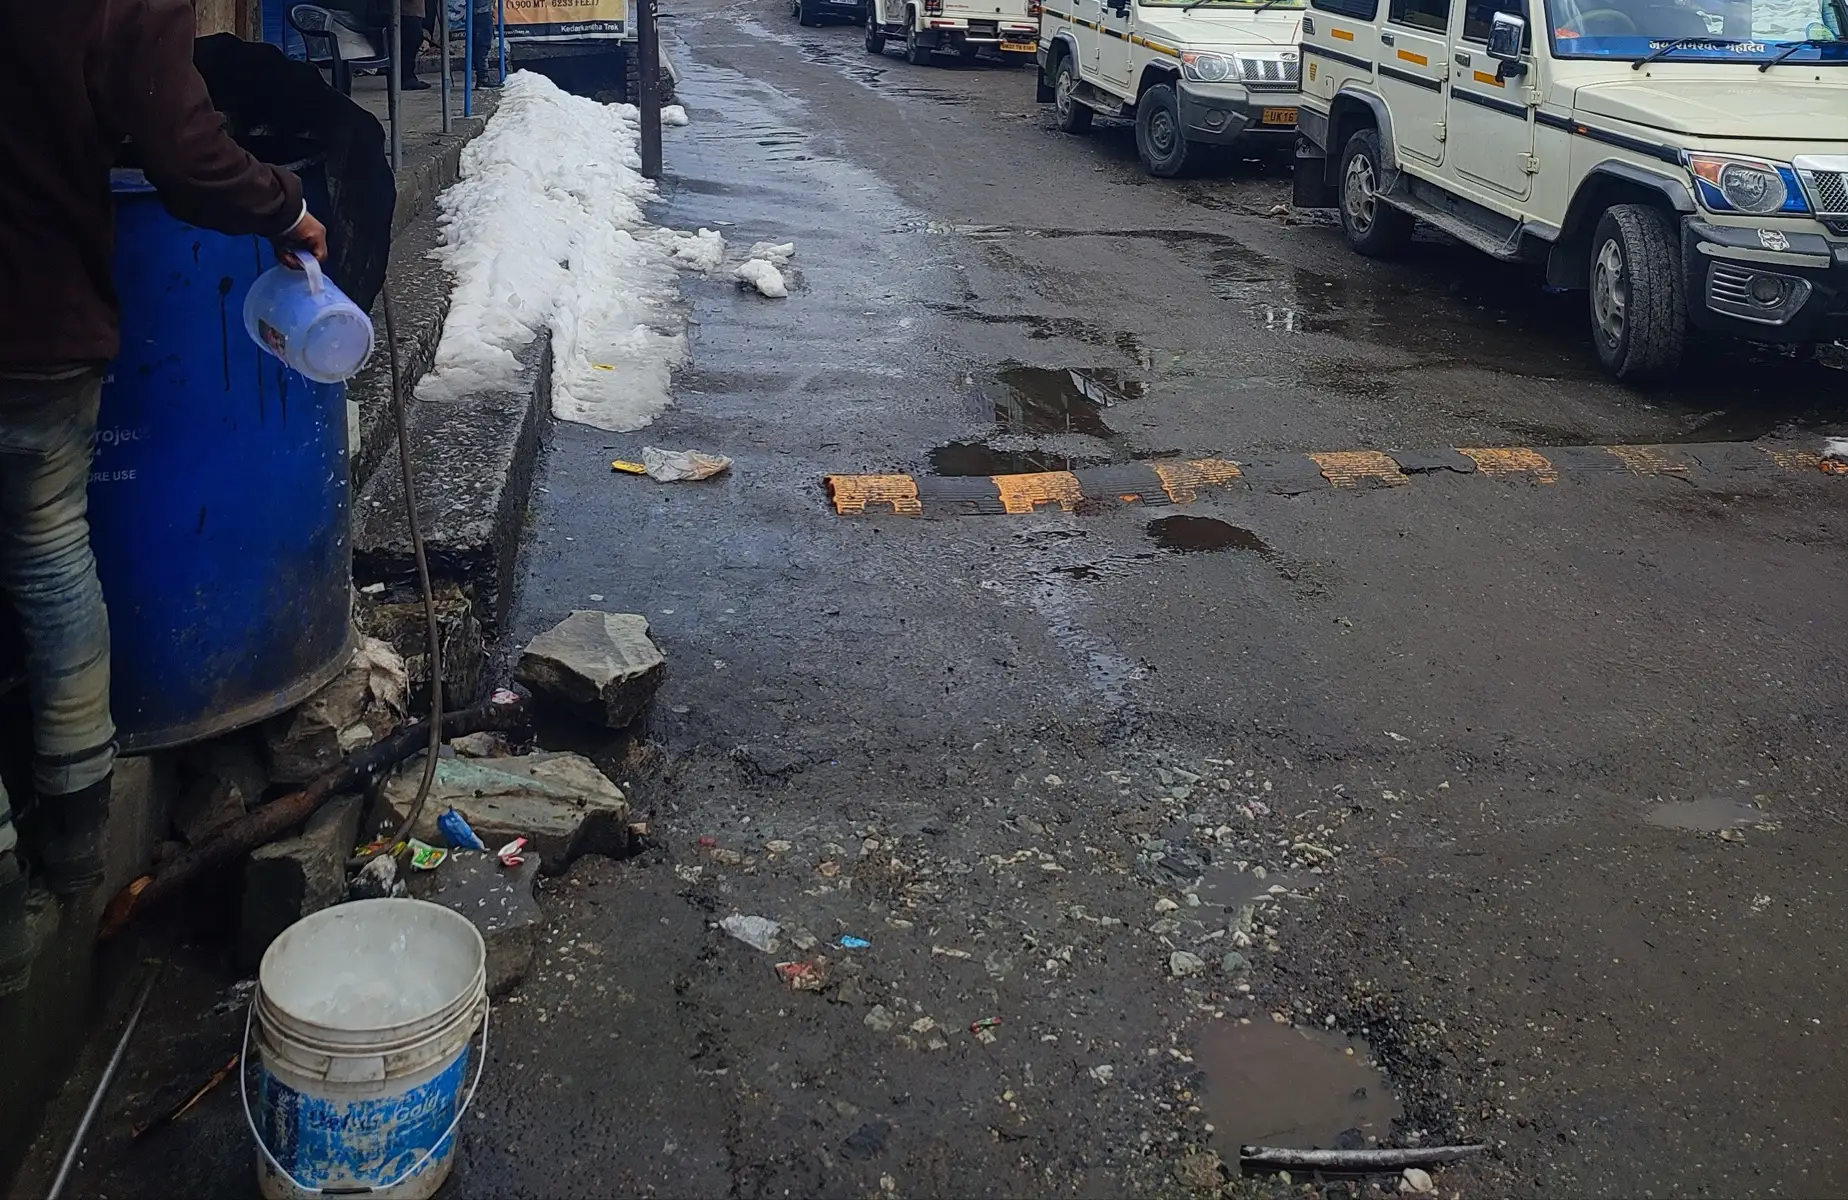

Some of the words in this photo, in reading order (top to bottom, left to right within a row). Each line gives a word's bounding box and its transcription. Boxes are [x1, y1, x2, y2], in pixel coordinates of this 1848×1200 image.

[505, 0, 532, 9] (1900
[560, 23, 603, 33] Kedarkantha
[604, 23, 619, 32] Trek
[112, 469, 137, 481] USE
